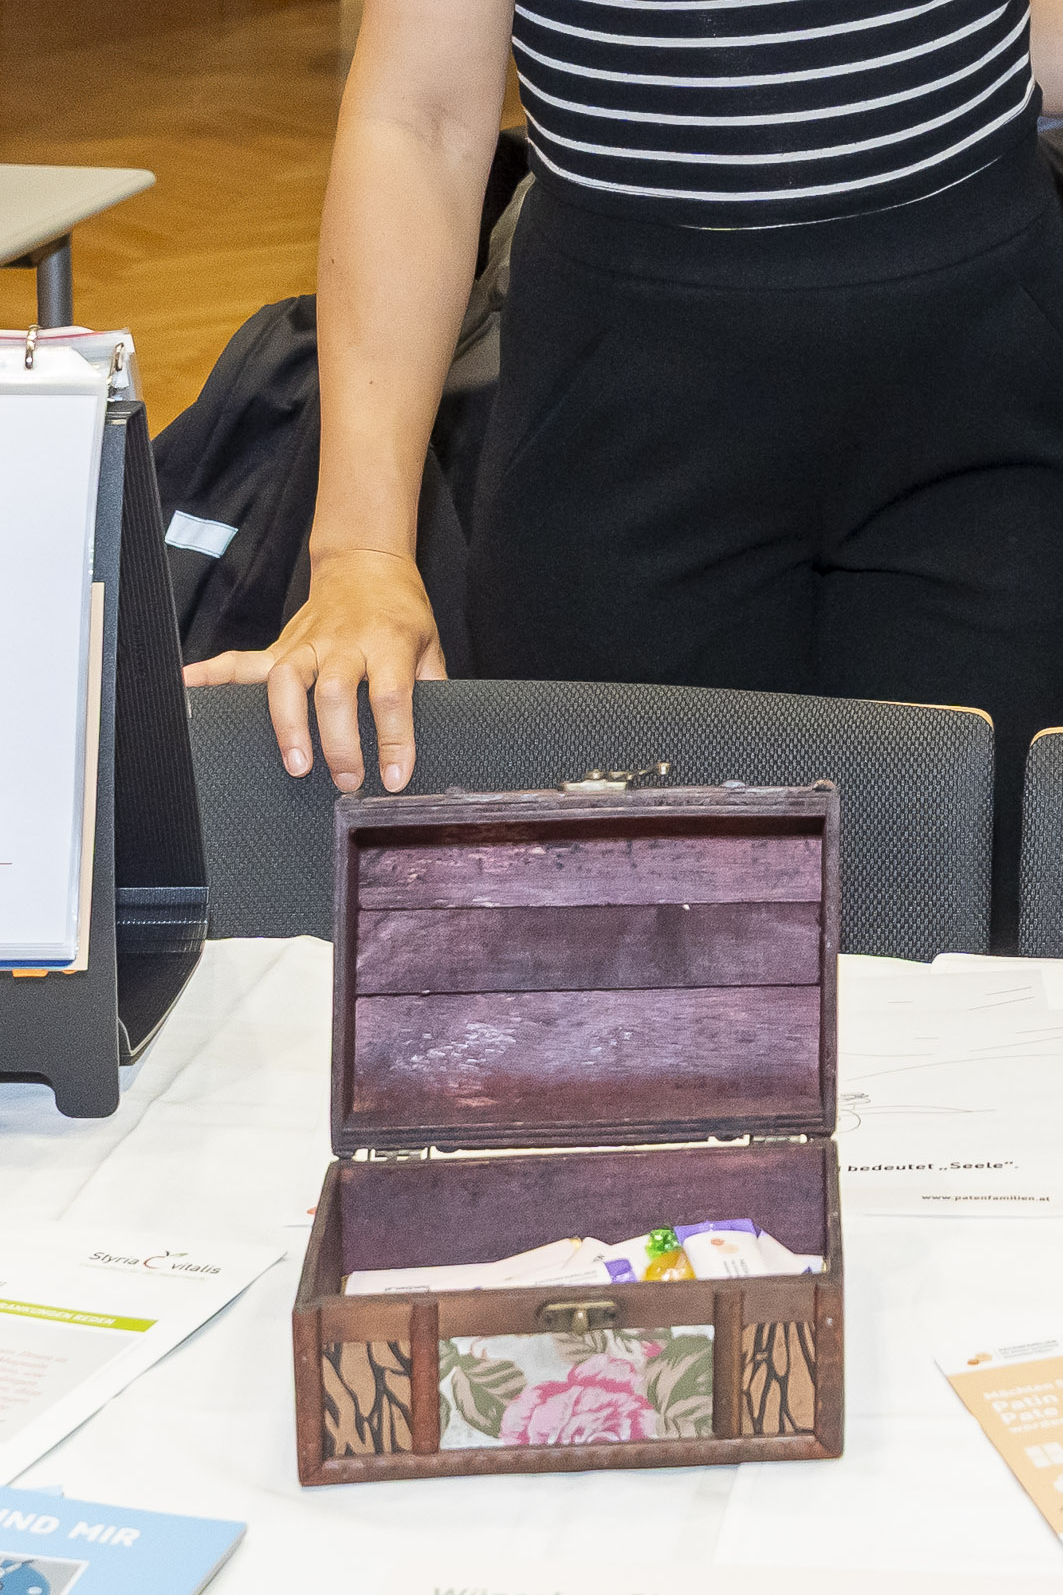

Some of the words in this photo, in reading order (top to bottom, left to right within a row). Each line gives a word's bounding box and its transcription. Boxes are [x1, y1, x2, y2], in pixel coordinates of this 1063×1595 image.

[847, 1162, 934, 1173] bedeutet
[88, 1251, 140, 1267] Styria
[171, 1262, 223, 1275] vitalis
[72, 1313, 116, 1326] REDEN
[990, 1392, 1059, 1413] Patin
[1001, 1406, 1060, 1426] Pate
[67, 1521, 141, 1548] MIR
